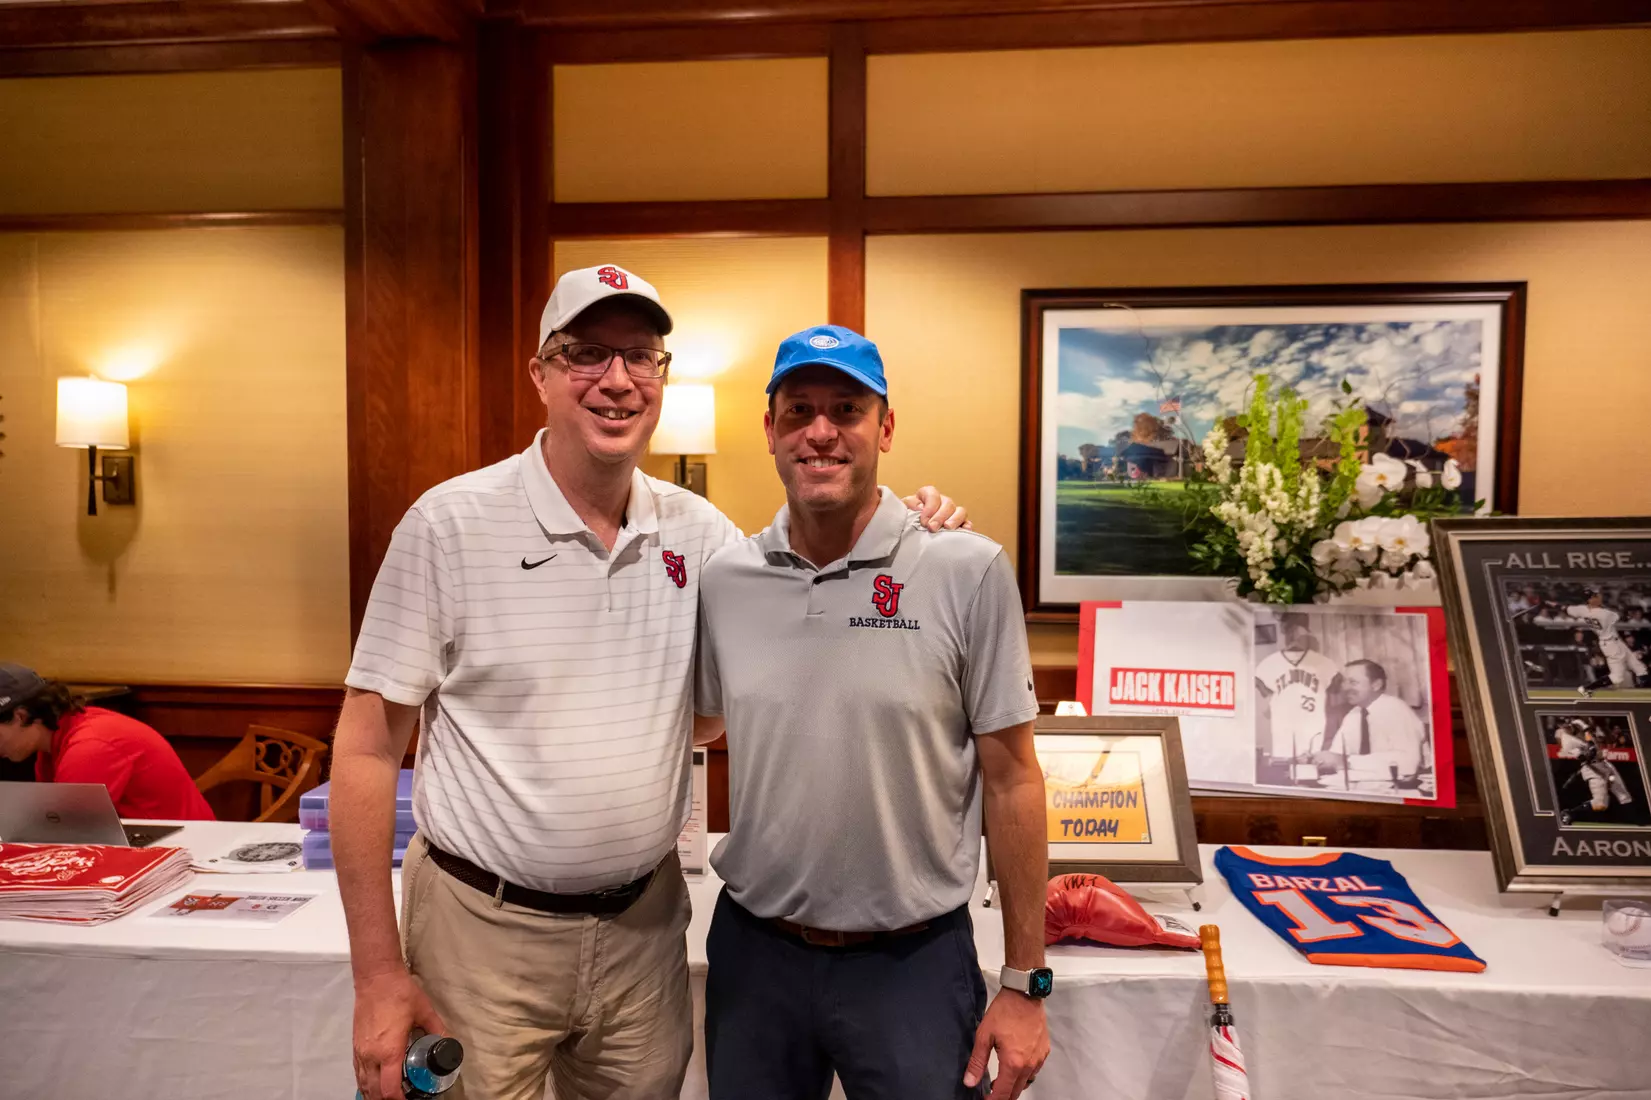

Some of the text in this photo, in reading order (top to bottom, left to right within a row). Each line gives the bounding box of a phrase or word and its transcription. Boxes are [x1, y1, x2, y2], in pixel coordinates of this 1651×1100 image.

[1505, 552, 1561, 569] ALL
[849, 617, 920, 630] BASKETBALL
[1111, 671, 1234, 705] JACK KAISER
[1053, 789, 1138, 809] CHAMPION
[1061, 818, 1119, 838] TODAY
[1247, 873, 1383, 892] BARZAL
[1251, 888, 1462, 949] 13
